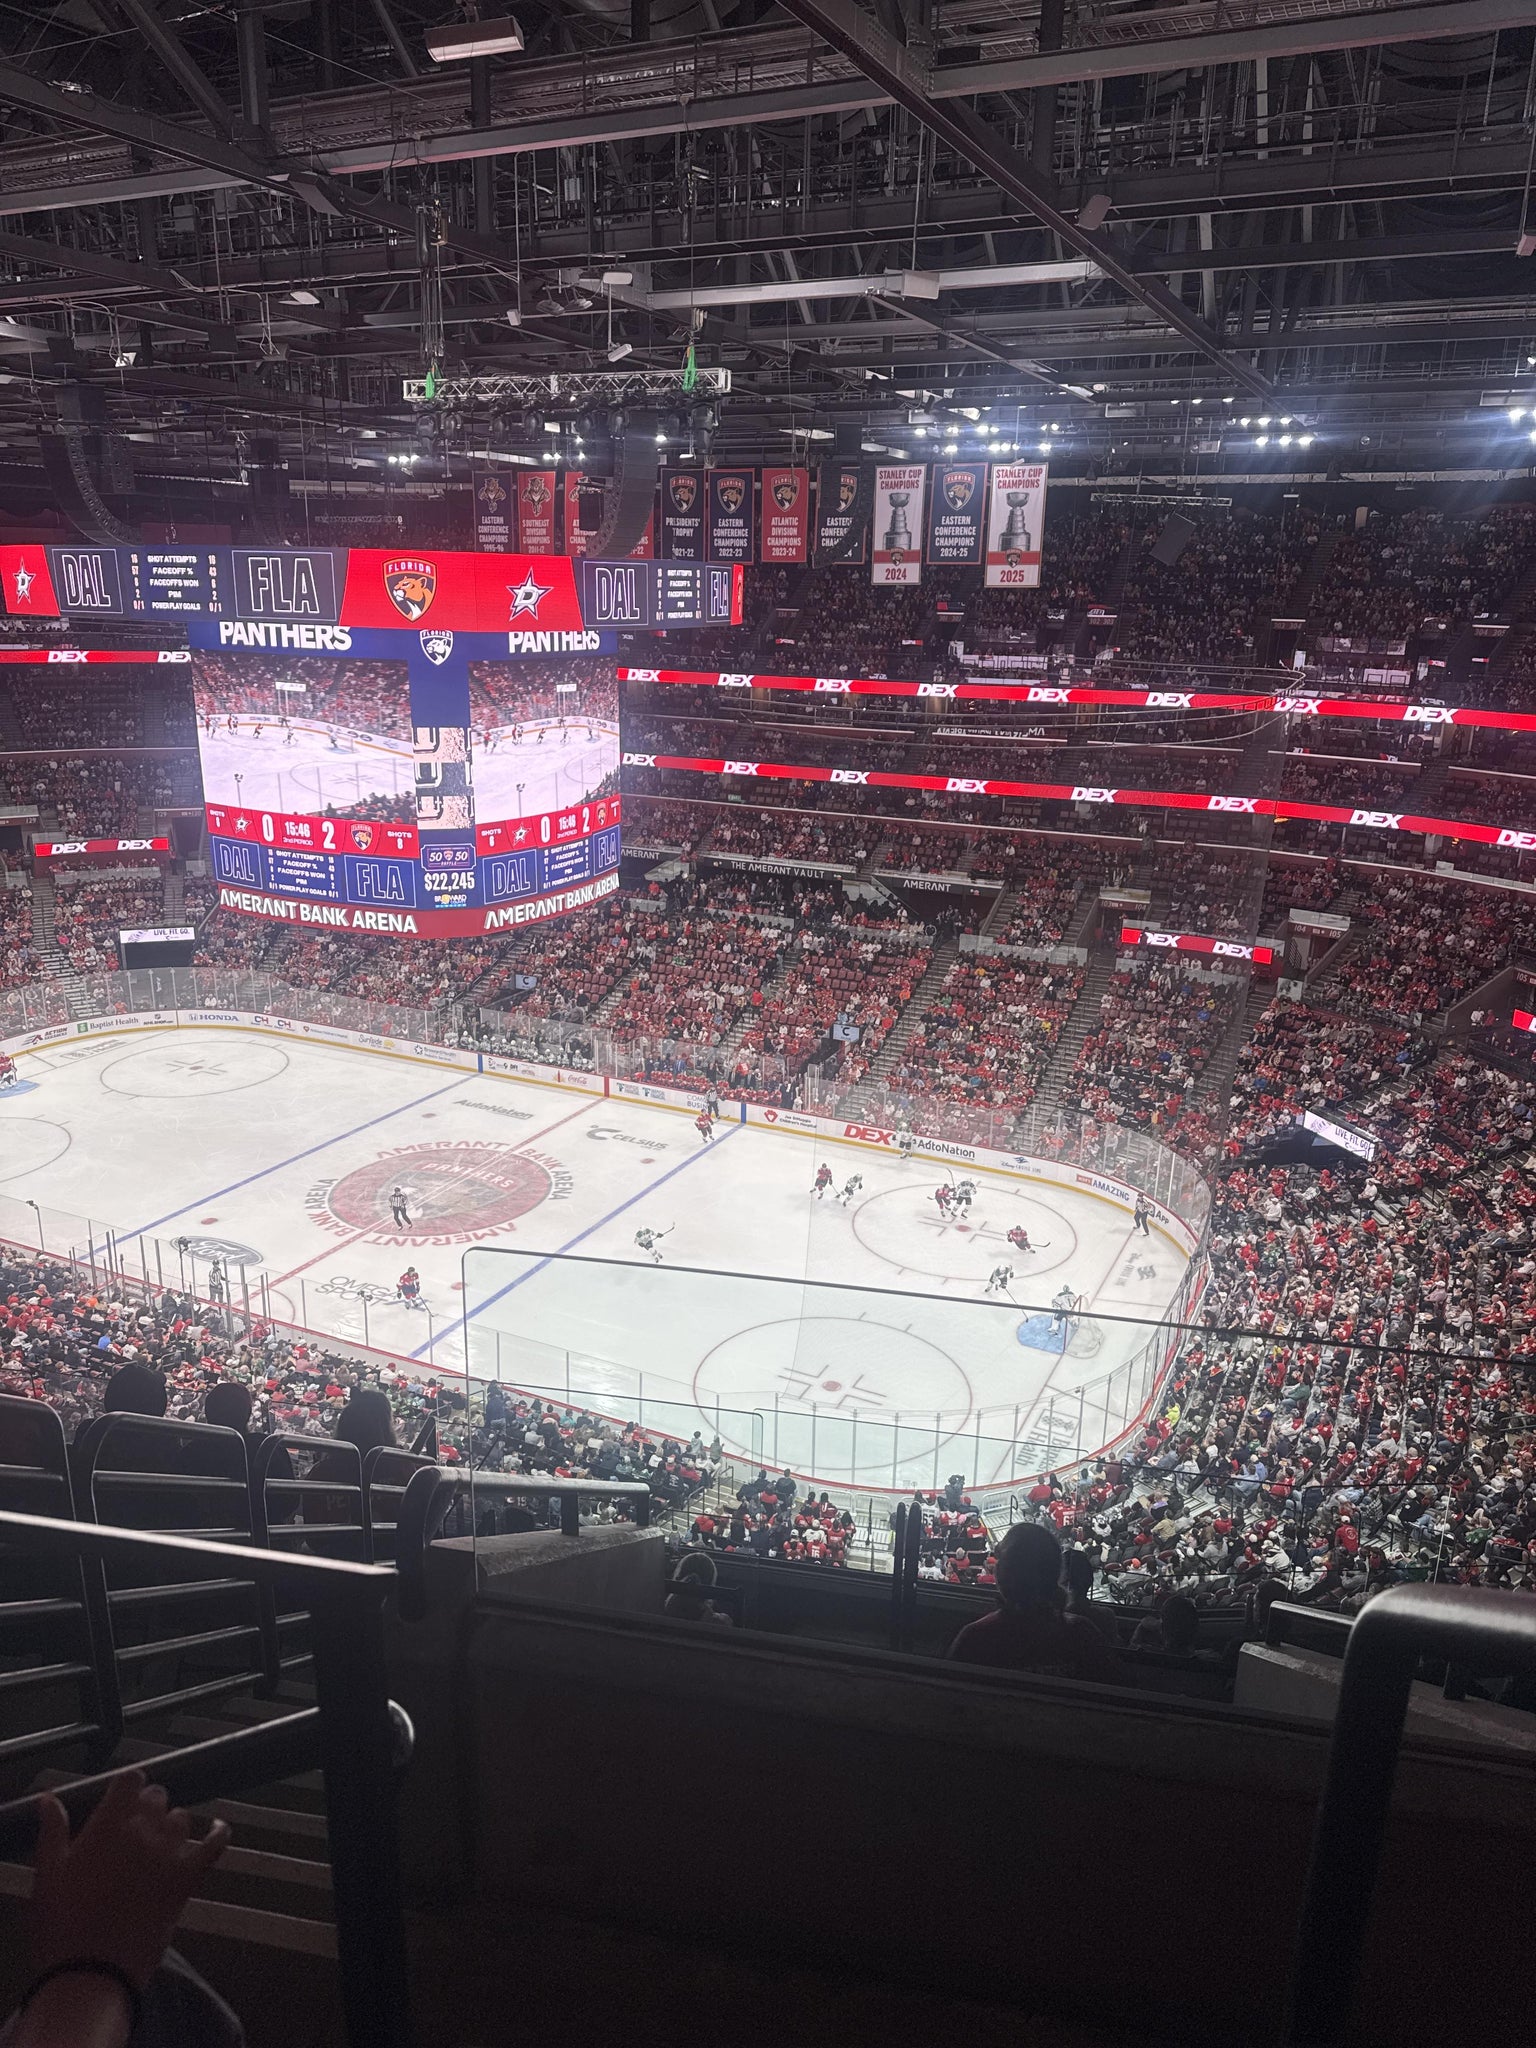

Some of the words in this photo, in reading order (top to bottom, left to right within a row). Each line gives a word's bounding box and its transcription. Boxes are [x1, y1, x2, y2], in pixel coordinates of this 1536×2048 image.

[879, 470, 906, 480] STANLEY
[909, 469, 922, 478] CUP
[996, 469, 1025, 479] STANLEY
[1029, 468, 1043, 477] CUP
[880, 480, 920, 490] CHAMPIONS
[997, 479, 1040, 490] CHAMPIONS
[718, 518, 744, 527] EASTERN
[771, 517, 798, 526] ATLANTIC
[941, 516, 971, 525] EASTERN
[478, 526, 509, 534] CONFERENCE
[672, 528, 694, 537] TROPHY
[713, 528, 748, 537] CONFERENCE
[771, 528, 798, 536] DIVISION
[935, 526, 976, 536] CONFERENCE
[479, 535, 508, 544] CHAMPIONS
[714, 538, 748, 547] CHAMPIONS
[767, 538, 801, 546] CHAMPIONS
[935, 537, 974, 546] CHAMPIONS
[718, 548, 743, 556] 2022-23
[772, 548, 796, 556] 2023-24
[940, 548, 968, 557] 2024-25
[152, 567, 186, 575] FACEOFF
[388, 561, 432, 574] FLORIDA
[885, 567, 907, 580] 2024
[62, 554, 112, 606] DAL
[150, 579, 183, 587] FACEOFFS
[1000, 570, 1025, 582] 2025
[248, 556, 320, 614] FLA
[212, 591, 217, 600] 2
[595, 568, 640, 620] DAL
[710, 571, 729, 616] FLA
[219, 621, 352, 650] PANTHERS
[508, 630, 600, 654] PANTHERS
[48, 650, 90, 663] DEX
[627, 668, 662, 682] DEX
[718, 673, 754, 688] DEX
[814, 678, 854, 692] DEX
[917, 684, 962, 698] DEX
[1027, 688, 1070, 703] DEX
[1145, 692, 1195, 708] DEX
[1274, 698, 1323, 714] DEX
[1402, 706, 1458, 724] DEX
[622, 752, 658, 767] DEX
[723, 762, 760, 776] DEX
[830, 770, 870, 784] DEX
[946, 778, 988, 794] DEX
[1070, 786, 1118, 803] DEX
[1206, 796, 1259, 813] DEX
[582, 806, 590, 833] 2
[1349, 810, 1406, 830] DEX
[262, 814, 274, 842] 0
[284, 822, 310, 838] 15:46
[481, 828, 502, 836] SHOTS
[540, 816, 550, 843] 0
[322, 821, 336, 850] 2
[51, 841, 89, 854] DEX
[117, 839, 154, 850] DEX
[598, 832, 617, 868] FLA
[429, 852, 442, 862] 50
[454, 851, 468, 861] 50
[620, 848, 660, 860] AMERANT
[220, 844, 255, 881] DAL
[283, 860, 312, 869] FACEOFF
[278, 868, 310, 876] FACEOFFS
[310, 871, 326, 879] WON
[492, 858, 530, 896] DAL
[731, 861, 746, 870] THE
[748, 863, 791, 876] AMERANT
[793, 867, 825, 880] VAULT
[356, 863, 405, 900] FLA
[424, 872, 476, 892] $22,245
[903, 880, 952, 892] AMERANT
[484, 896, 566, 929] AMERANT
[566, 883, 594, 908] BANK
[594, 872, 620, 899] ARENA
[220, 887, 298, 922] AMERANT
[300, 902, 350, 927] BANK
[352, 911, 418, 934] ARENA
[1294, 924, 1306, 933] 104
[1329, 928, 1341, 938] 105
[1212, 941, 1255, 959] DEX
[1516, 973, 1527, 982] 105
[90, 1020, 114, 1030] Baptist
[116, 1017, 139, 1026] Health
[200, 1014, 240, 1022] HONDA
[254, 1016, 269, 1025] CH
[277, 1019, 292, 1028] CH
[44, 1028, 68, 1036] ACTION
[454, 1099, 534, 1120] AutoNation
[612, 1134, 670, 1150] CELSIUS
[844, 1124, 894, 1146] DEX
[918, 1140, 976, 1159] AutoNation
[376, 1140, 510, 1160] AMERANT
[520, 1148, 565, 1172] BANK
[549, 1170, 574, 1200] ARENA
[422, 1162, 515, 1189] PANTHERS
[305, 1177, 339, 1210] ARENA
[1092, 1180, 1130, 1202] AMAZING
[308, 1211, 358, 1238] BANK
[363, 1222, 518, 1247] AMERANT
[190, 1240, 247, 1262] Ford
[329, 1276, 400, 1299] OMEGA
[1014, 1431, 1048, 1466] Health
